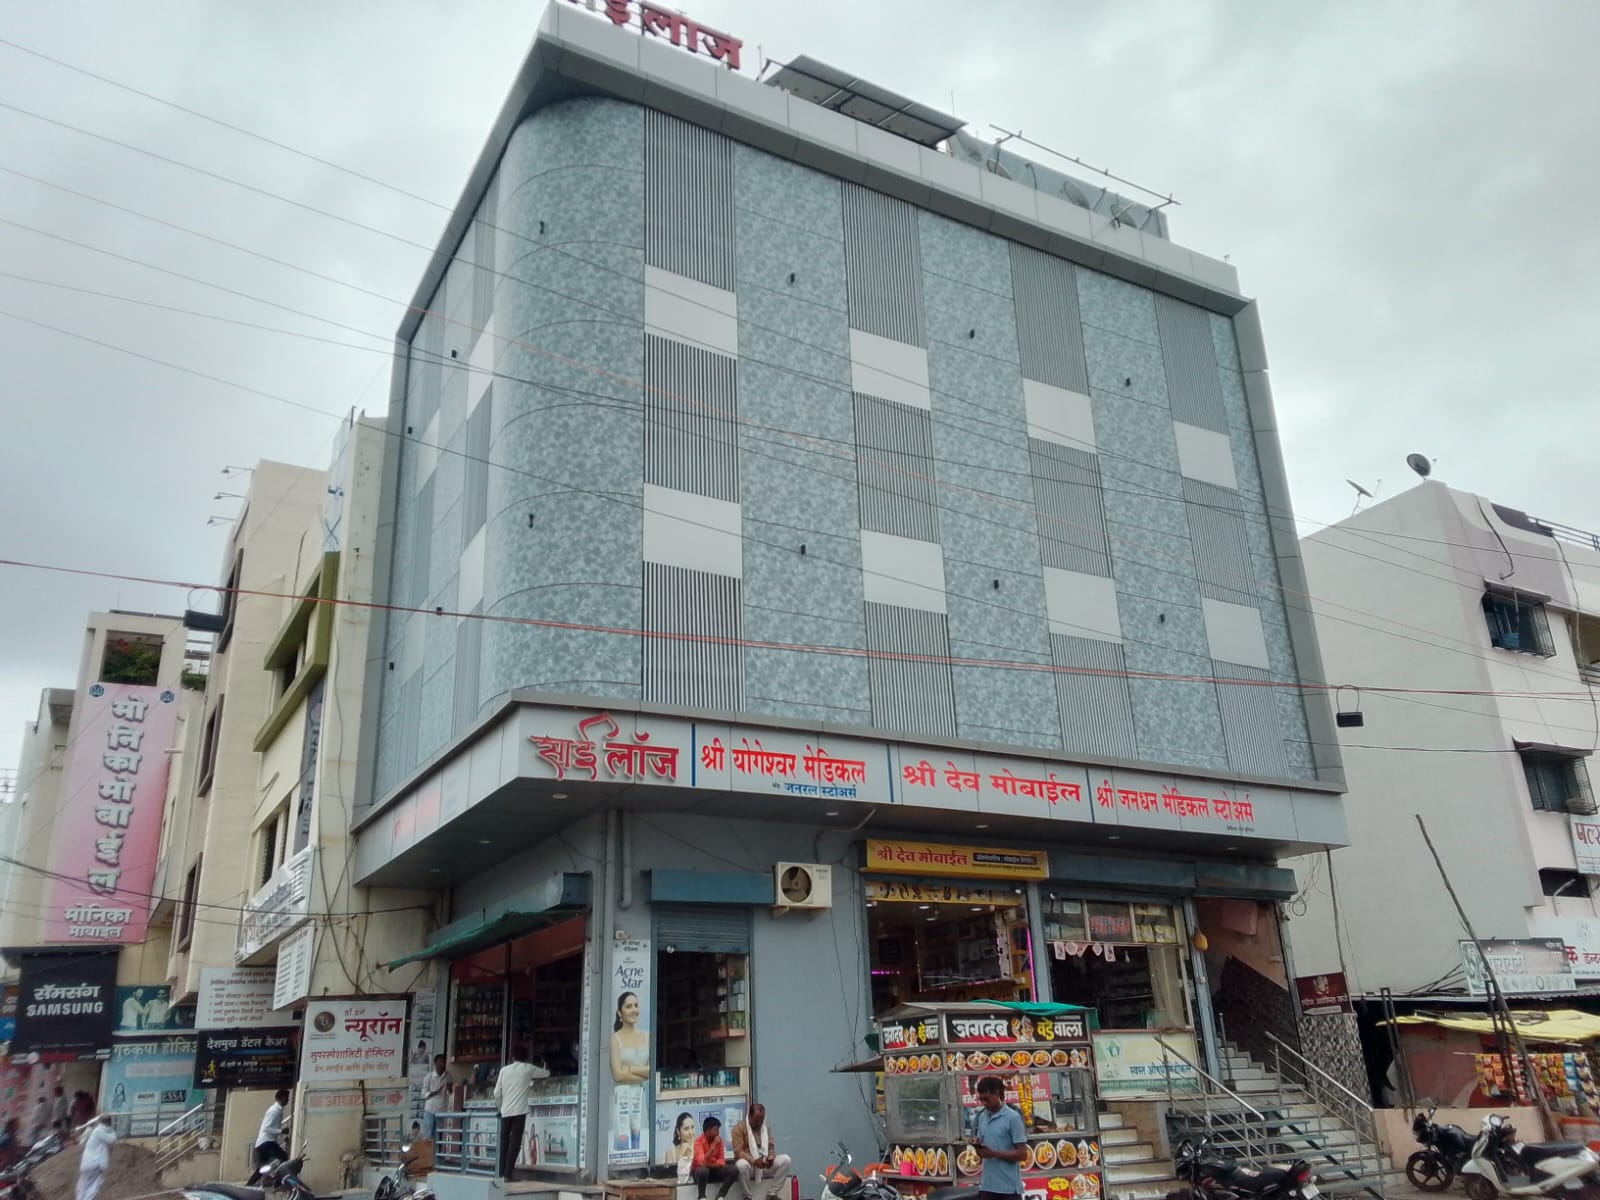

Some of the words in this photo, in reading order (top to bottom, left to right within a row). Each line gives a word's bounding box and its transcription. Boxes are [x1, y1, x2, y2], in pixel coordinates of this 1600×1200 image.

[529, 711, 620, 780] साई
[604, 731, 679, 781] लॉज
[701, 737, 725, 772] श्री
[732, 738, 797, 779] योगेश्वर
[803, 745, 866, 784] मेडिकल
[784, 783, 817, 796] जनरल
[820, 783, 857, 799] स्टोअर्स
[904, 760, 936, 789] श्री
[944, 761, 980, 793] देव
[989, 767, 1081, 807] मोबाईल
[1096, 779, 1114, 809] श्री
[1117, 787, 1158, 814] जनधन
[1162, 784, 1210, 818] मेडिकल
[1213, 789, 1255, 823] स्टोअर्स
[878, 845, 893, 862] श्री
[897, 846, 915, 863] देव
[918, 847, 968, 866] मोबाईल
[615, 964, 644, 978] Acne
[26, 1002, 104, 1017] SAMSUNG
[344, 1012, 402, 1041] न्यूरॉन
[952, 1014, 1009, 1039] जगदंब
[207, 1038, 238, 1051] देशमुख
